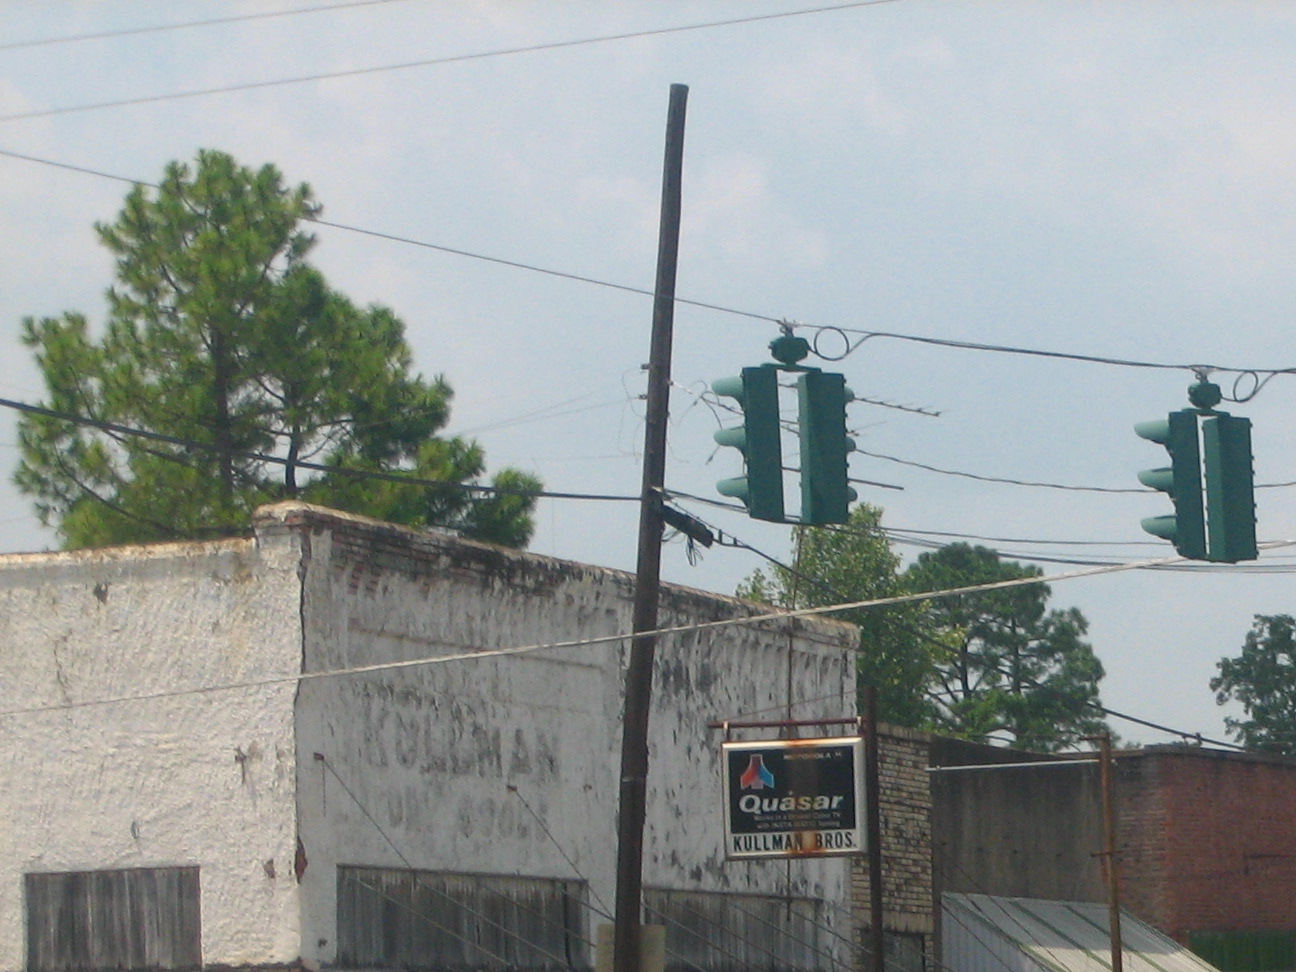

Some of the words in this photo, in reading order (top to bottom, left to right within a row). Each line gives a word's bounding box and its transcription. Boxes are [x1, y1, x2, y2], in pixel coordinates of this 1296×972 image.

[738, 794, 844, 815] Quasar
[733, 831, 802, 852] KULLMAN
[816, 831, 857, 849] BROS.
